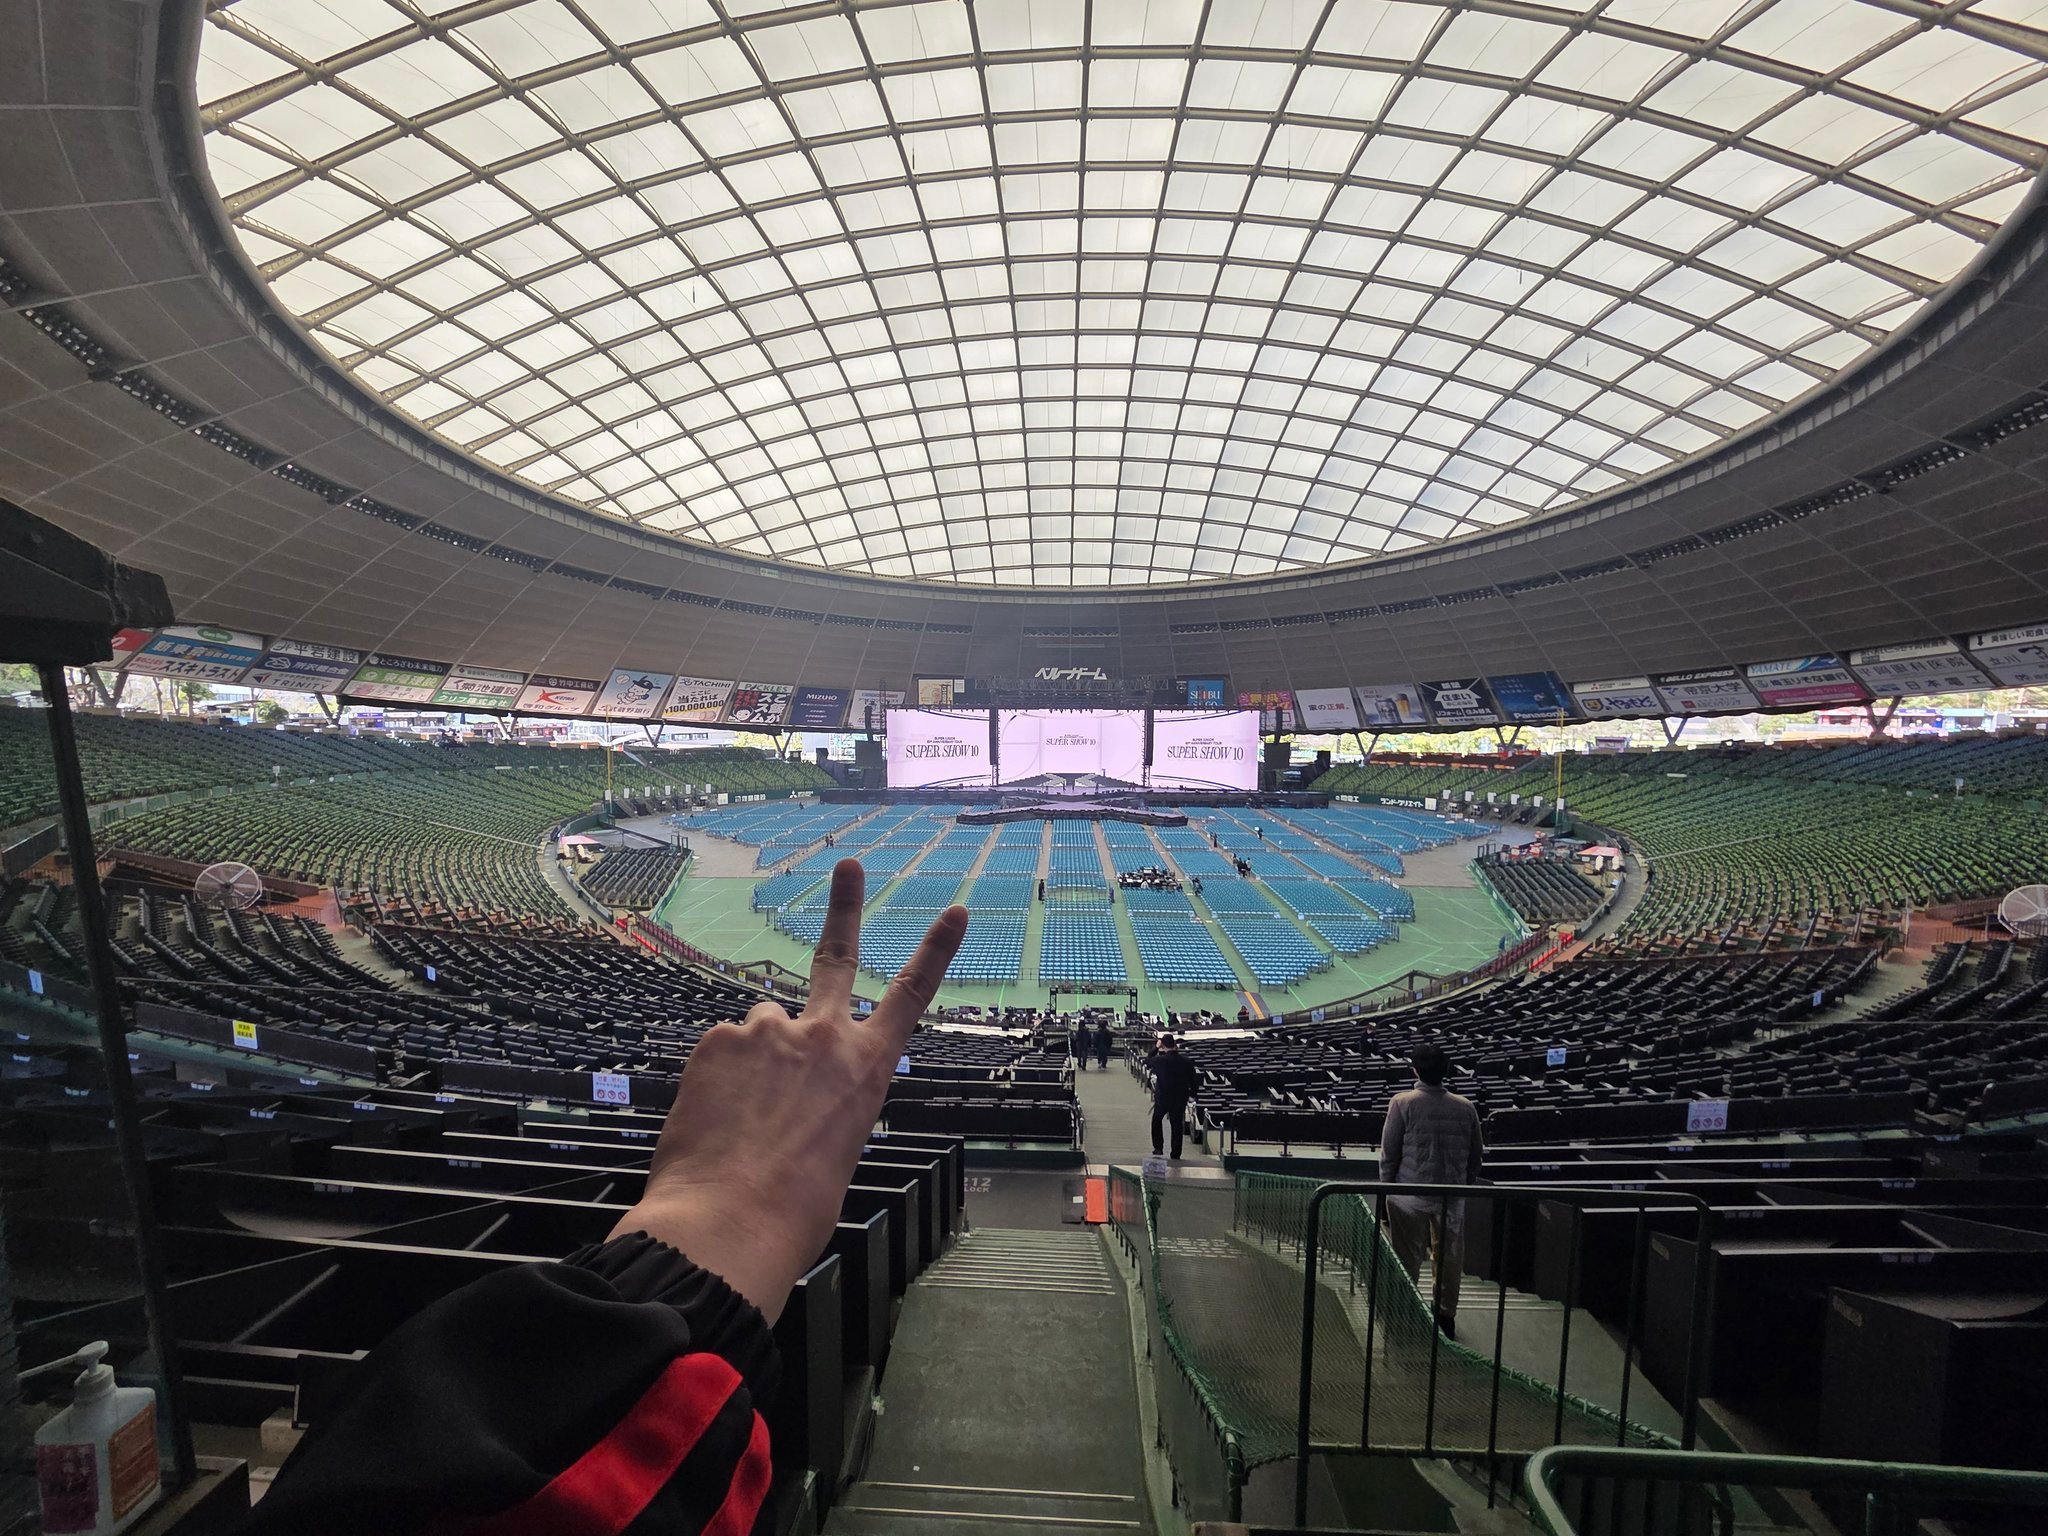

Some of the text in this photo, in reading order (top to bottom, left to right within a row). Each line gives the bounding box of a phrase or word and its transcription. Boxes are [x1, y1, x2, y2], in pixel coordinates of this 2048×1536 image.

[294, 641, 358, 663] 平岩建設
[158, 660, 243, 679] スズキトラスト
[1750, 662, 1793, 674] YAMATE
[1861, 656, 1969, 677] 平岡眼科医院
[1034, 667, 1107, 680] ベルーナドーム
[1770, 672, 1849, 687] 埼玉りそな銀行
[272, 679, 329, 690] TRINITY
[460, 682, 518, 696] 菊池建設
[692, 680, 732, 689] TACHIHI
[744, 683, 789, 692] PICKLES
[1684, 682, 1742, 695] 帝京大学
[1904, 675, 1986, 690] 日本電工
[438, 695, 509, 707] クリフ株式会社
[677, 694, 719, 704] 当たれば
[806, 693, 838, 701] MIZUHO
[906, 744, 979, 758] SUPER SHOW 10
[1167, 746, 1244, 760] SUPER SHOW 10
